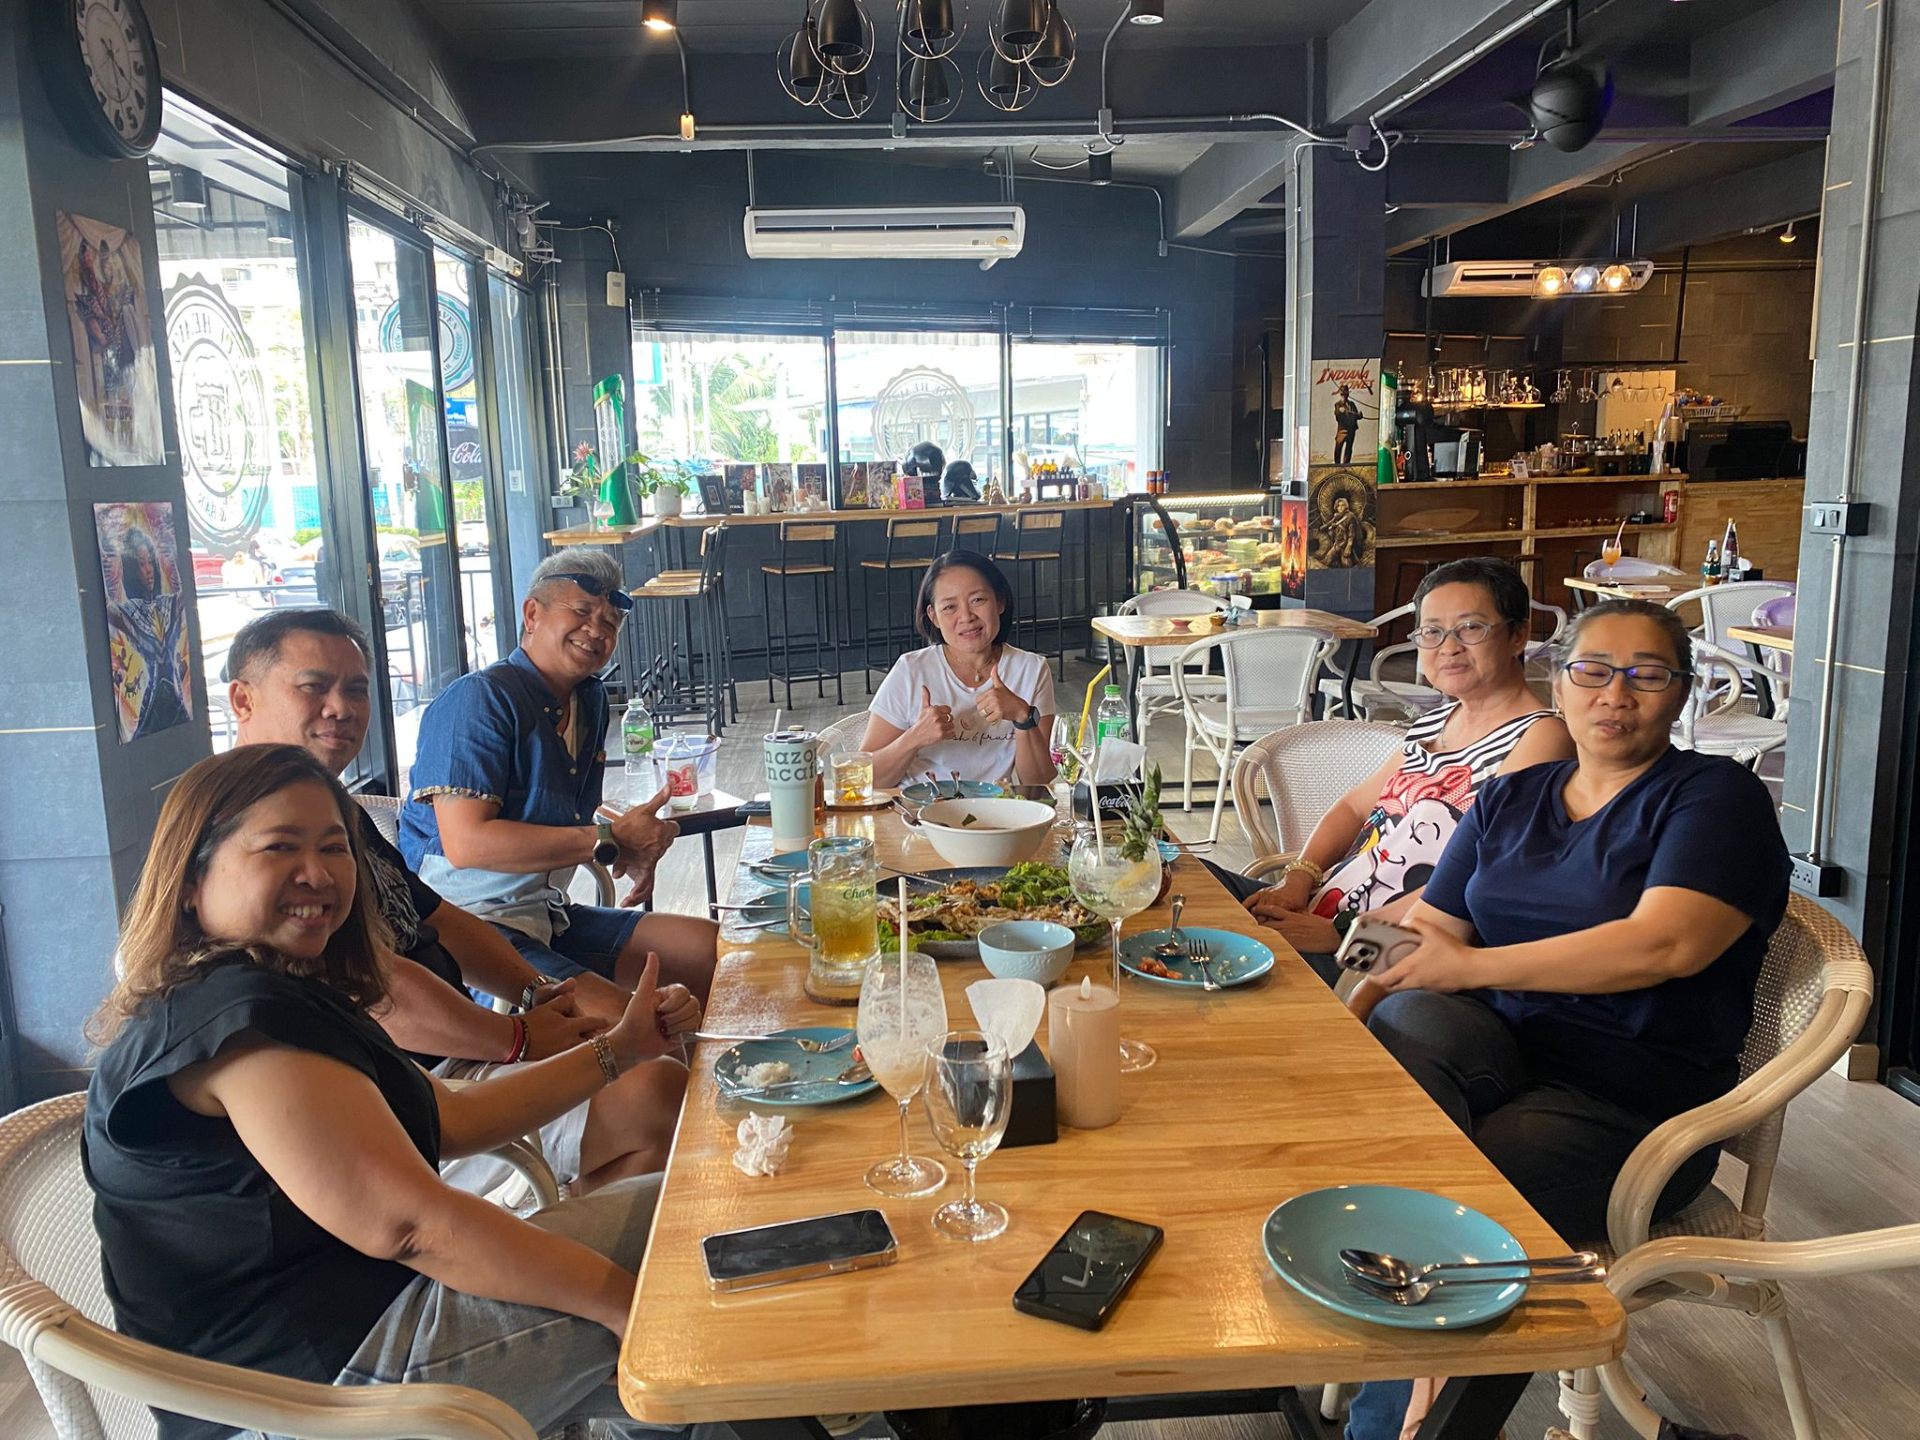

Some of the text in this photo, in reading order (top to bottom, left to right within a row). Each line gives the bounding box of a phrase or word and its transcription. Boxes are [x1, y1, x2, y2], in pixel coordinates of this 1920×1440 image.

[114, 109, 125, 132] 6
[1316, 368, 1370, 385] INDIANA
[979, 728, 1016, 746] fruit
